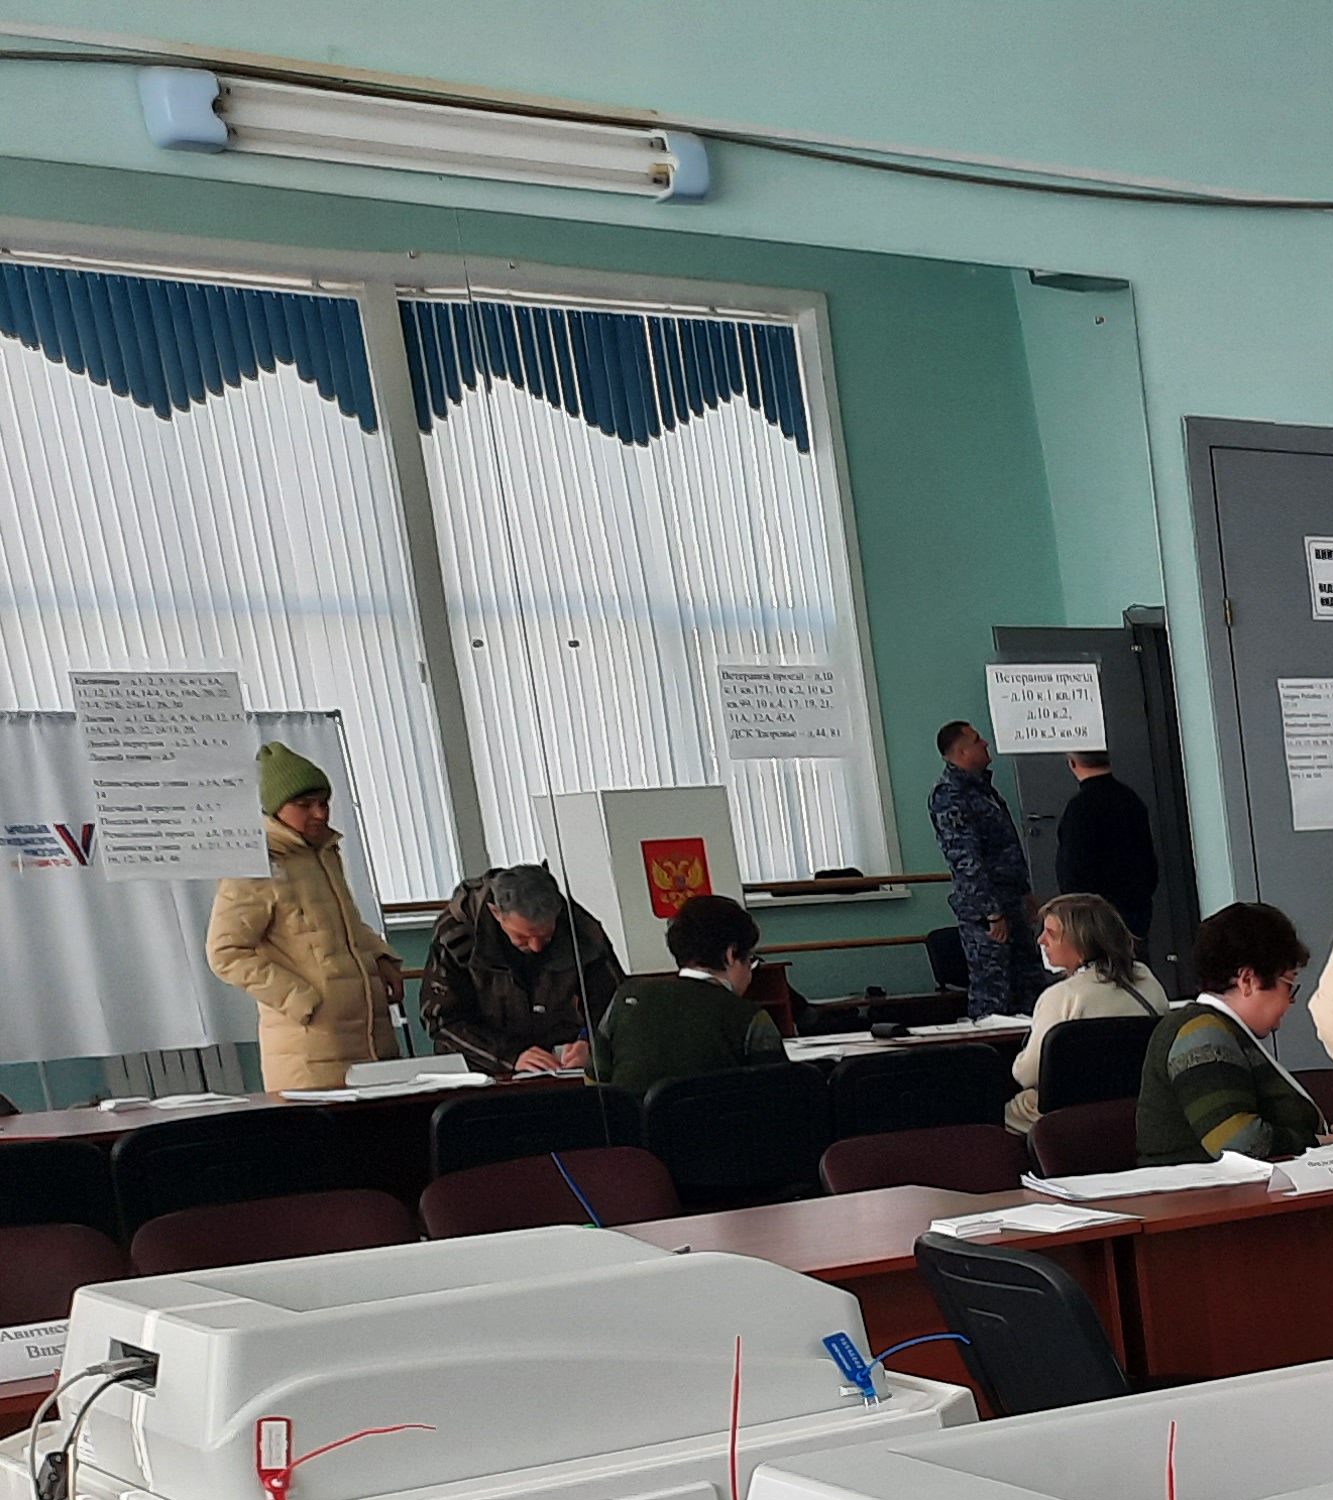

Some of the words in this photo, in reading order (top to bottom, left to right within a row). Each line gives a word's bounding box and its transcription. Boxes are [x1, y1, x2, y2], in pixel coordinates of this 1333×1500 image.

[995, 672, 1053, 686] Ветеранов
[1056, 673, 1093, 685] проезд
[1027, 707, 1050, 720] д.10
[1014, 727, 1038, 740] д.10
